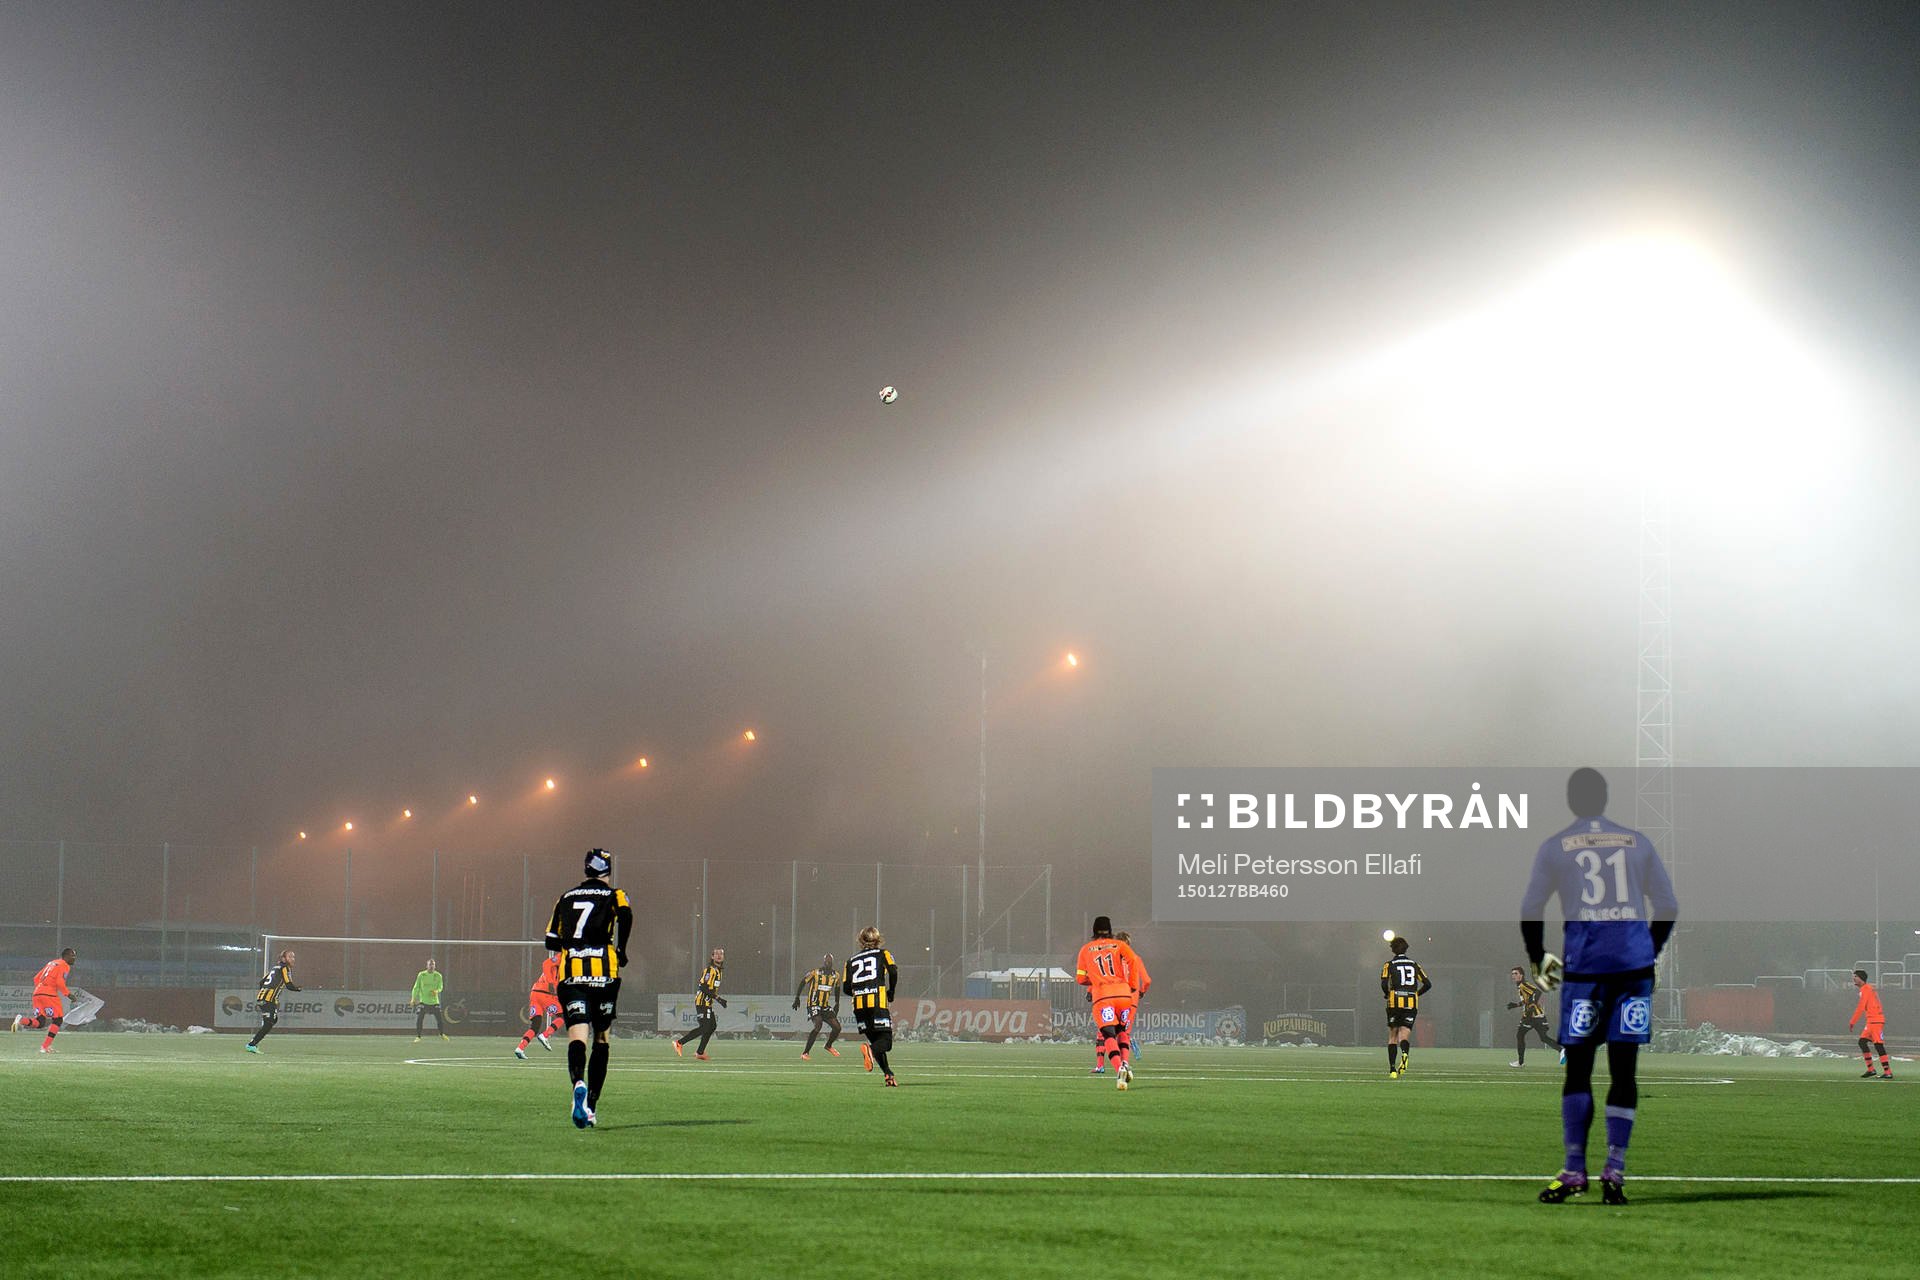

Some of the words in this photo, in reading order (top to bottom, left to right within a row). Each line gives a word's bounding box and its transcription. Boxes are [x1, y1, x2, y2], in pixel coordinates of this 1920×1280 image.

[1574, 848, 1629, 906] 31
[572, 901, 595, 939] 7
[851, 956, 877, 983] 23
[1093, 952, 1116, 977] 11
[1396, 965, 1416, 986] 13
[754, 1014, 791, 1023] bravida
[913, 1000, 1029, 1034] Penova
[1135, 1012, 1206, 1030] HJØRRING
[1263, 1017, 1327, 1038] KOPPARBERG
